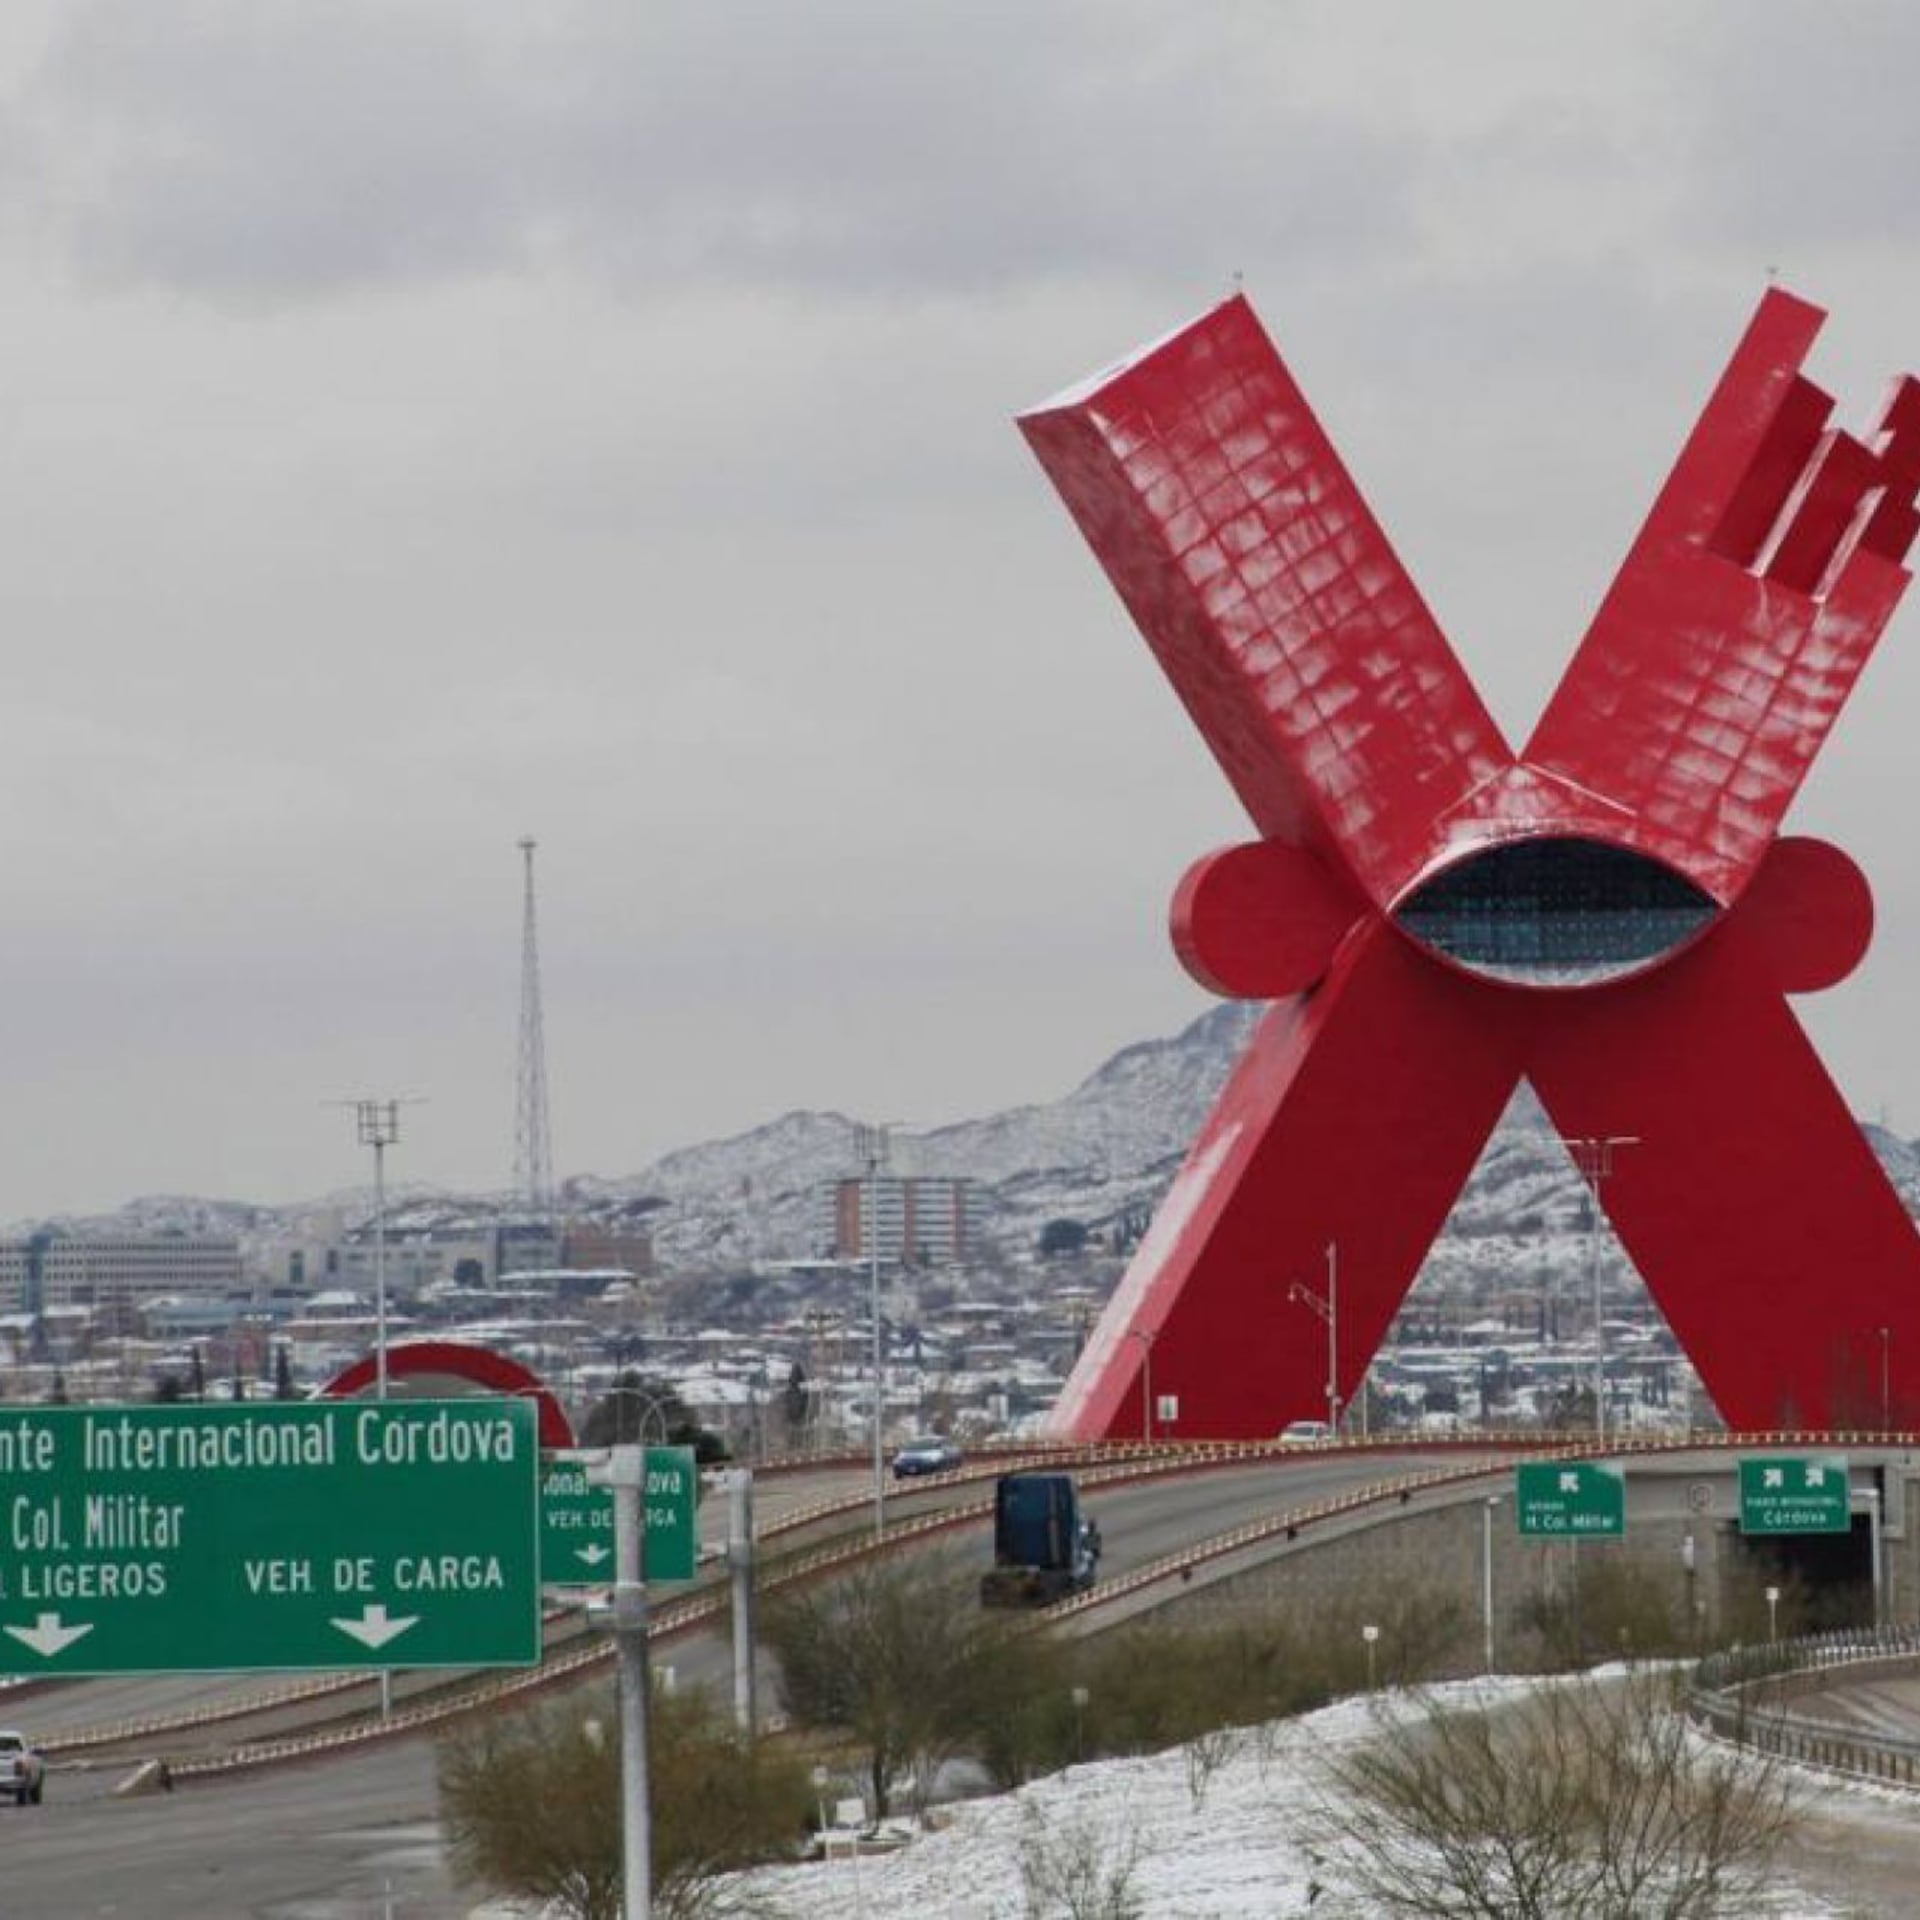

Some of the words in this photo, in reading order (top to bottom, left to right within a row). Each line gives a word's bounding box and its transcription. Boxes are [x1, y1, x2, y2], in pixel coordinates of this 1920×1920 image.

[84, 1414, 335, 1471] Internacional
[13, 1494, 70, 1550] Col.
[85, 1494, 184, 1549] Militar
[22, 1561, 165, 1598] LIGEROS
[334, 1558, 375, 1592] DE
[394, 1555, 504, 1590] CARGA
